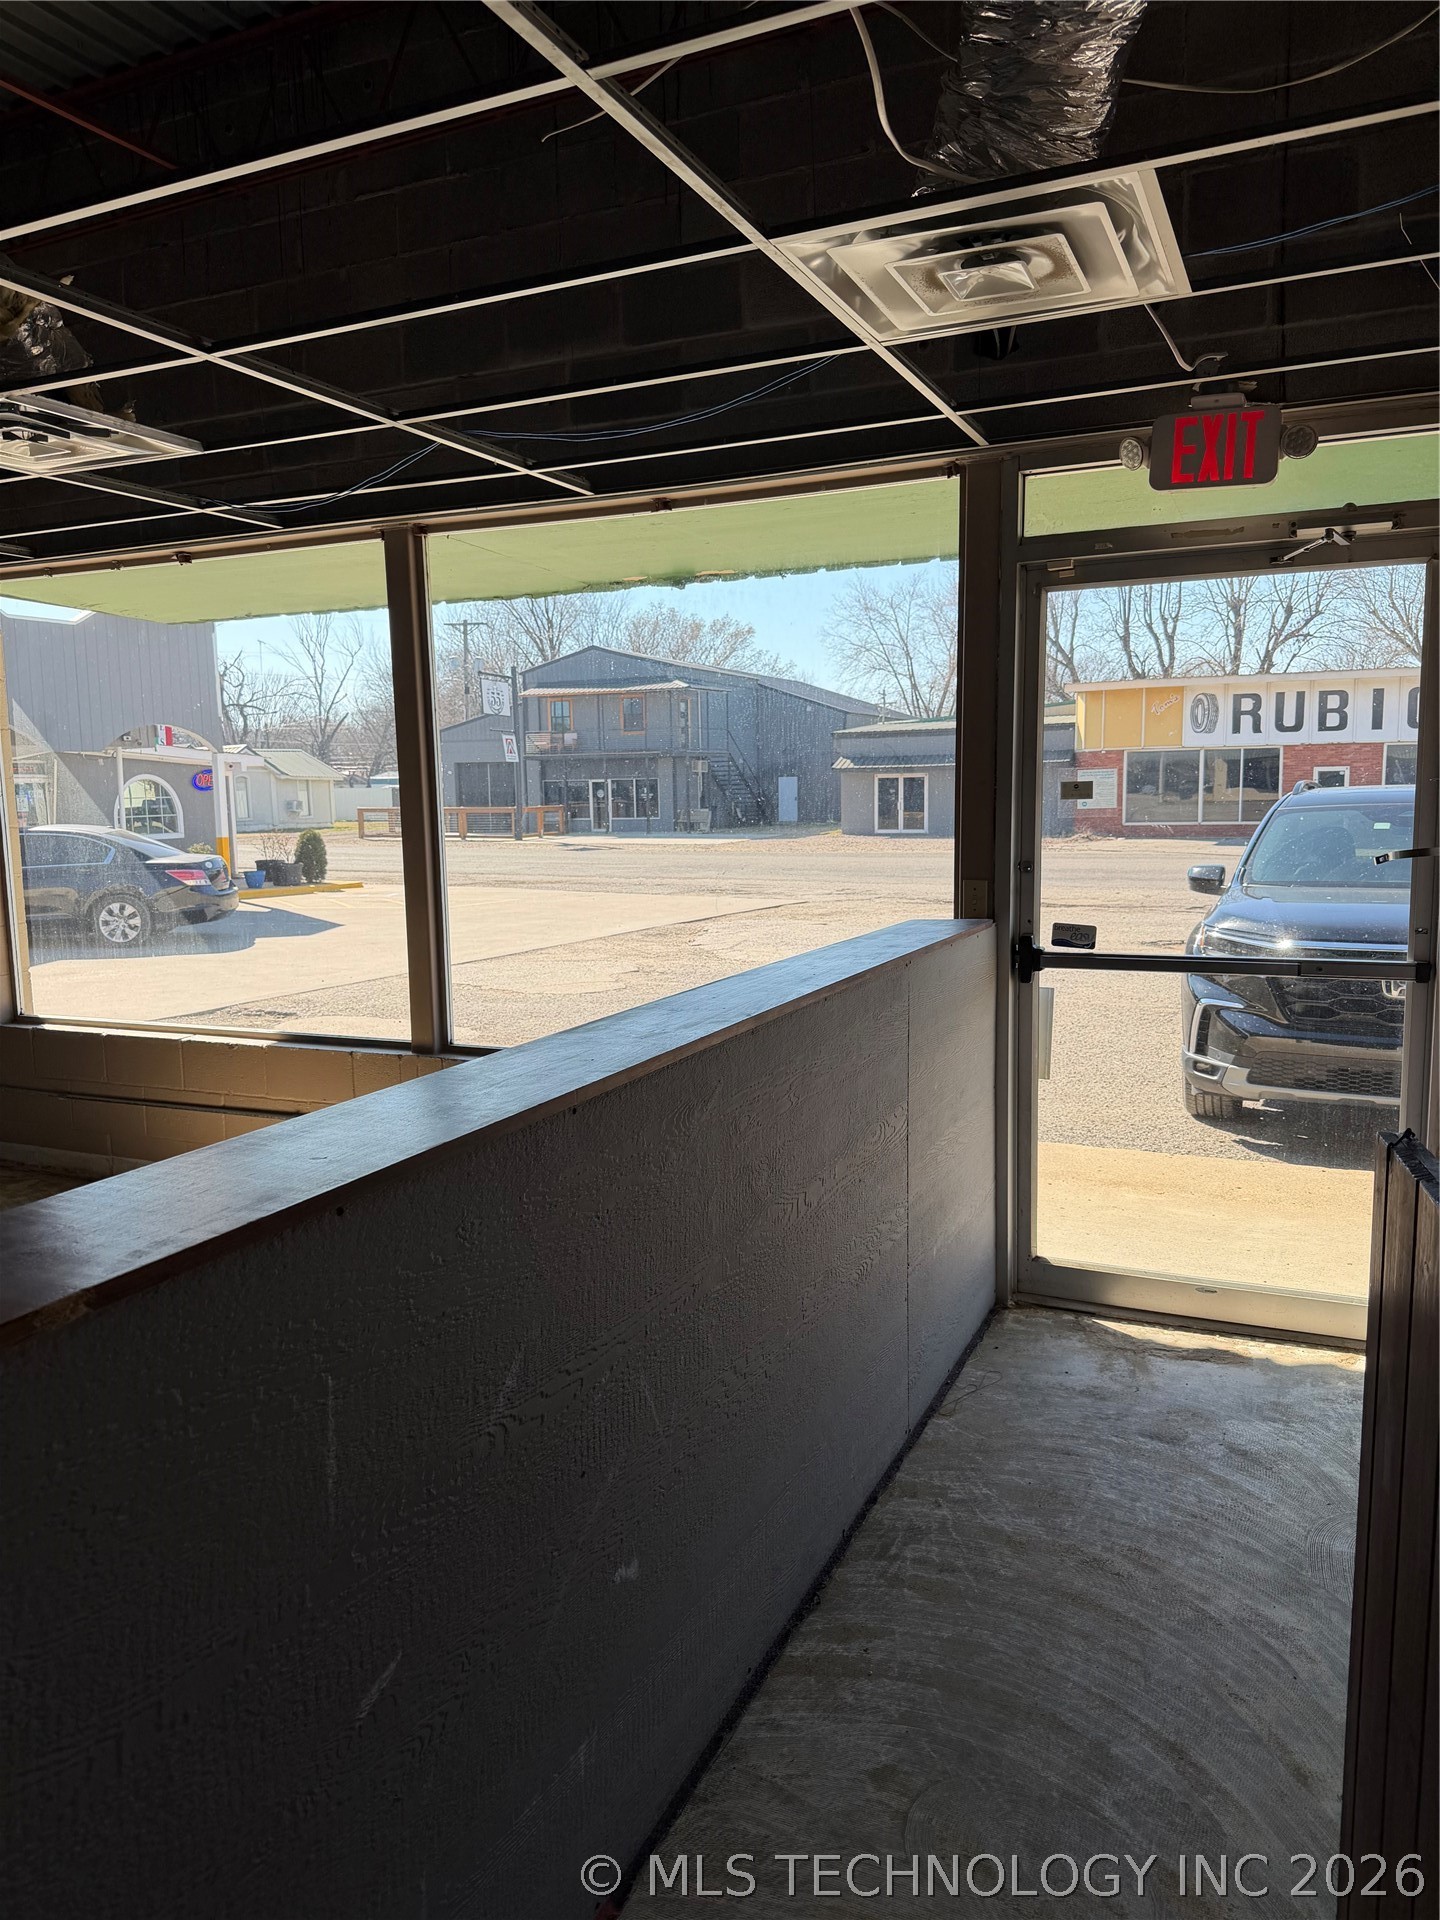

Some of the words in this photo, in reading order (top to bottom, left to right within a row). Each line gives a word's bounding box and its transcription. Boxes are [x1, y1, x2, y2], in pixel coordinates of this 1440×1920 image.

[1171, 410, 1265, 484] EXIT
[1151, 693, 1180, 716] Tom's
[196, 773, 213, 787] OPE
[1054, 924, 1081, 933] breathe
